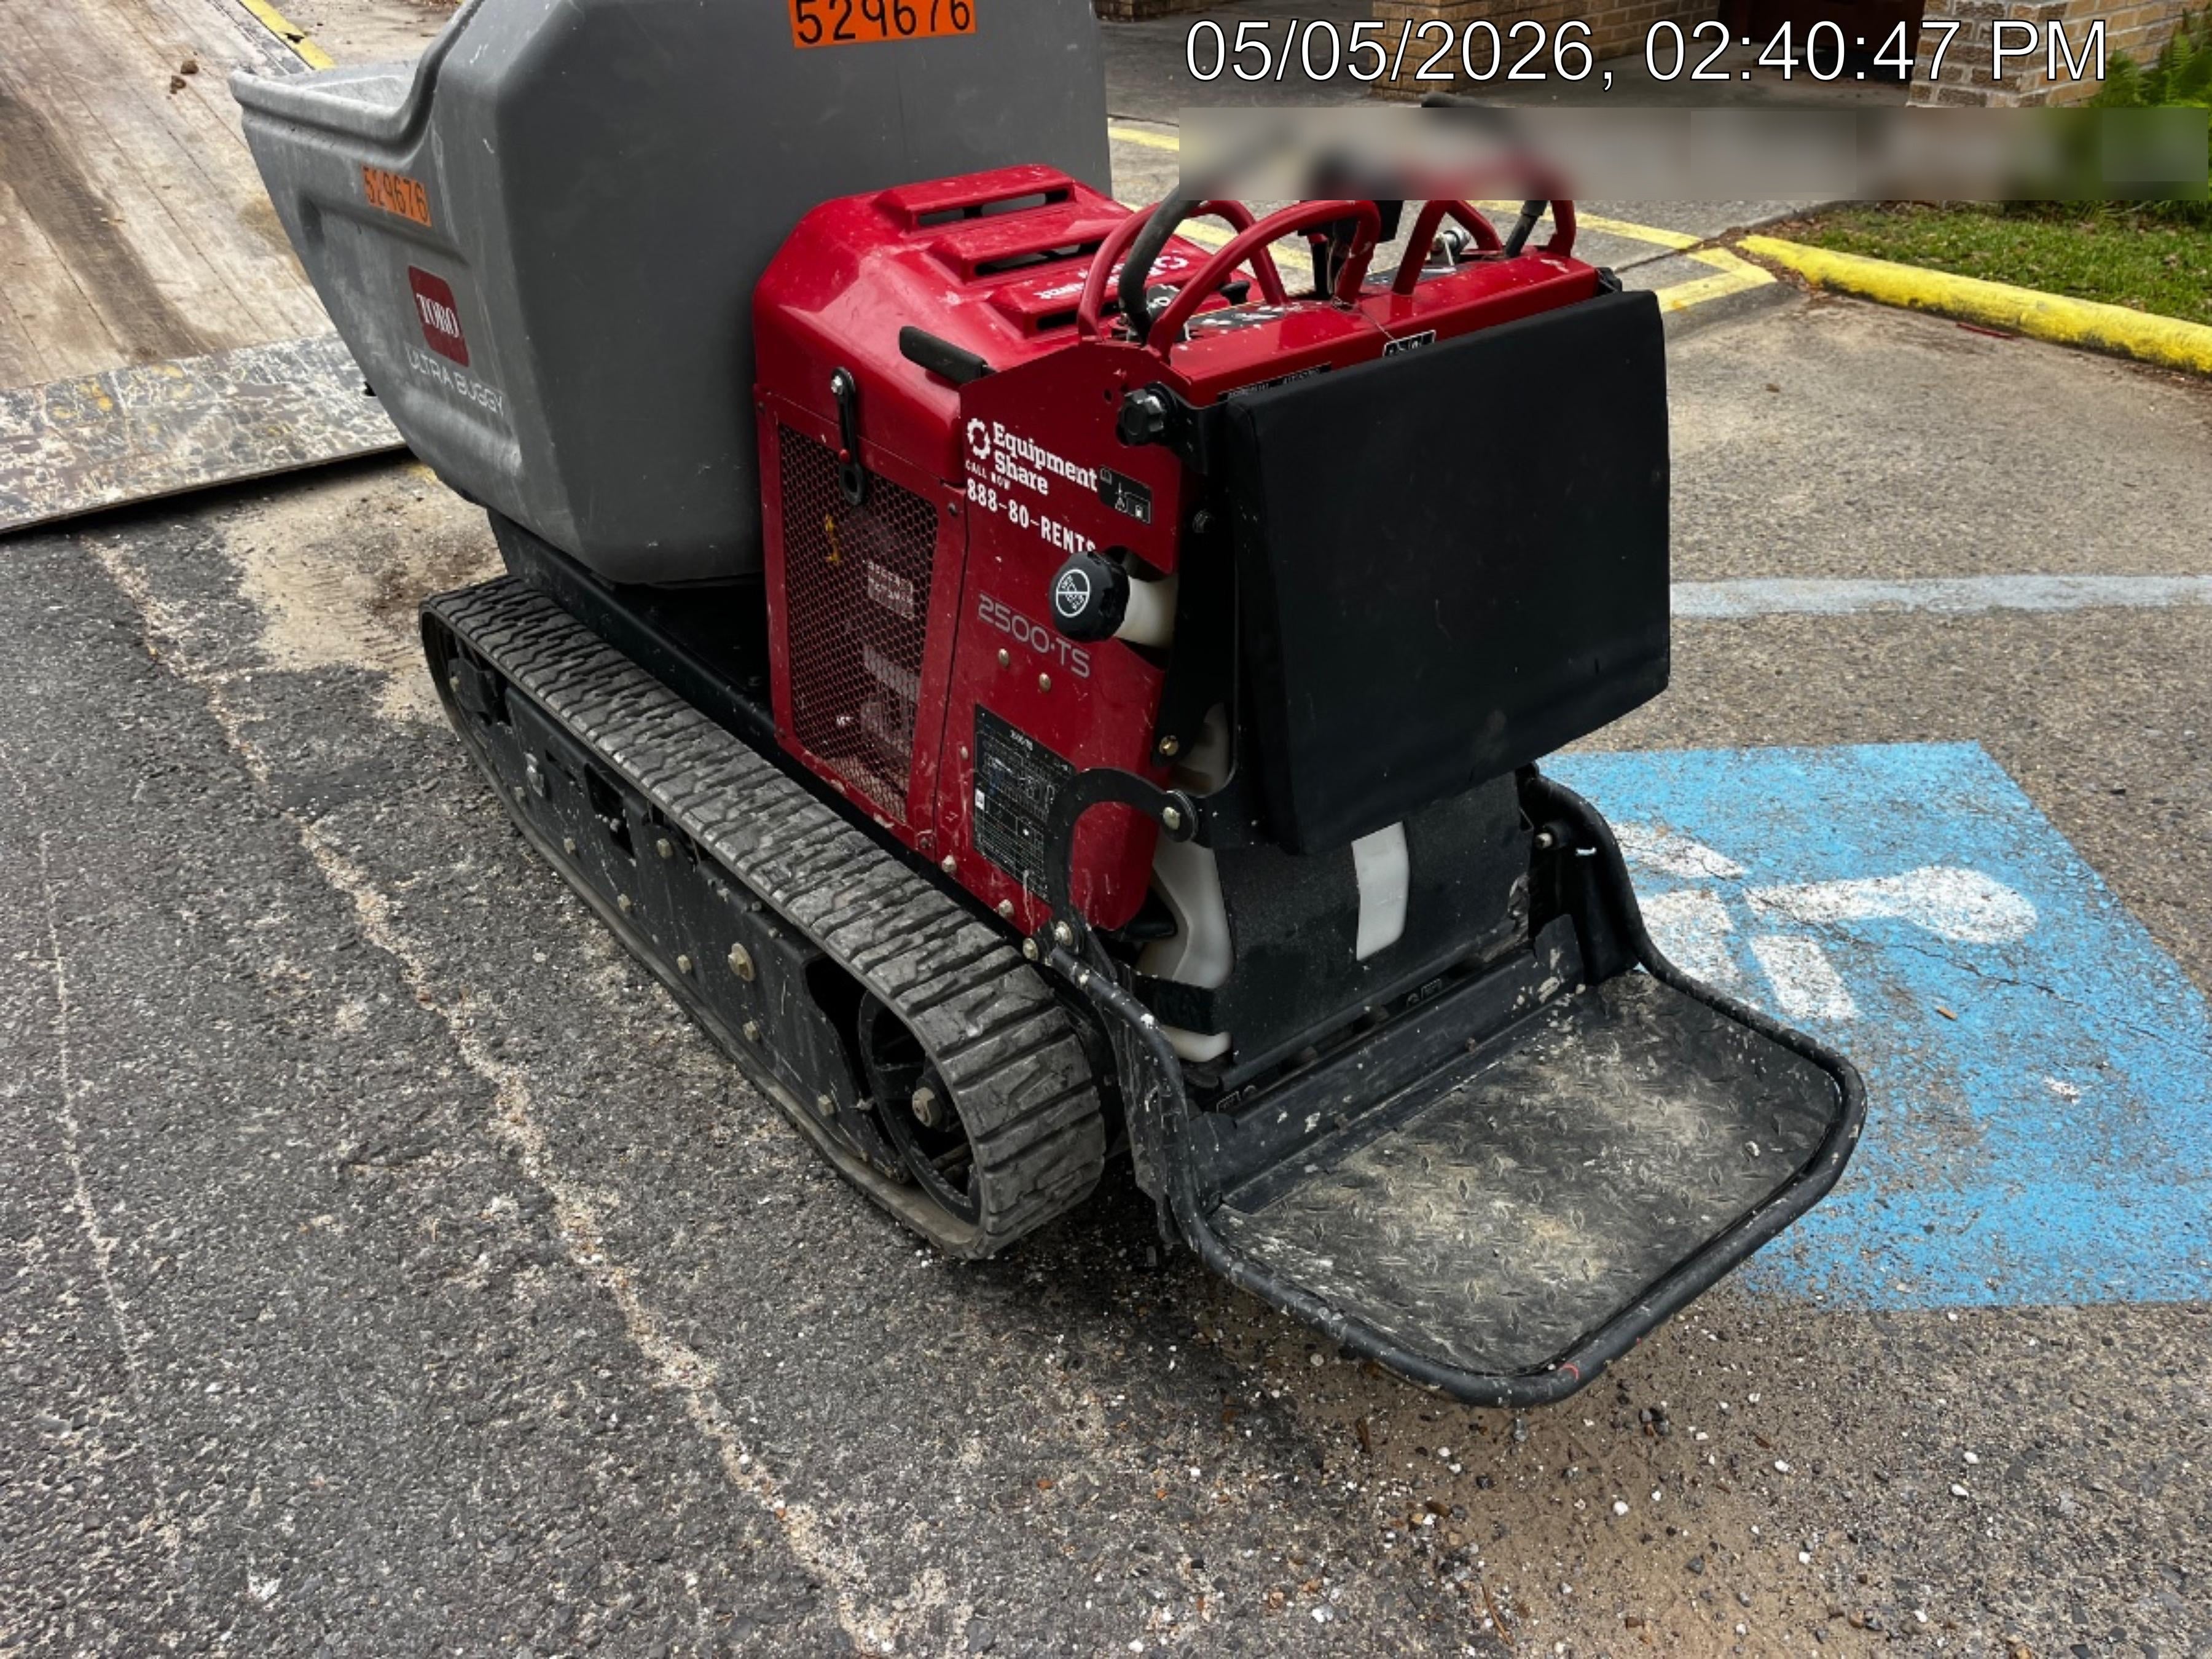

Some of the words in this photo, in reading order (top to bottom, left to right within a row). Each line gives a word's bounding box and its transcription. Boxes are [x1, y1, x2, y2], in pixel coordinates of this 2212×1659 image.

[796, 0, 971, 44] 529676
[363, 166, 429, 223] 529676
[416, 293, 460, 338] TORO
[993, 422, 1098, 493] Equipment
[994, 450, 1049, 496] Share
